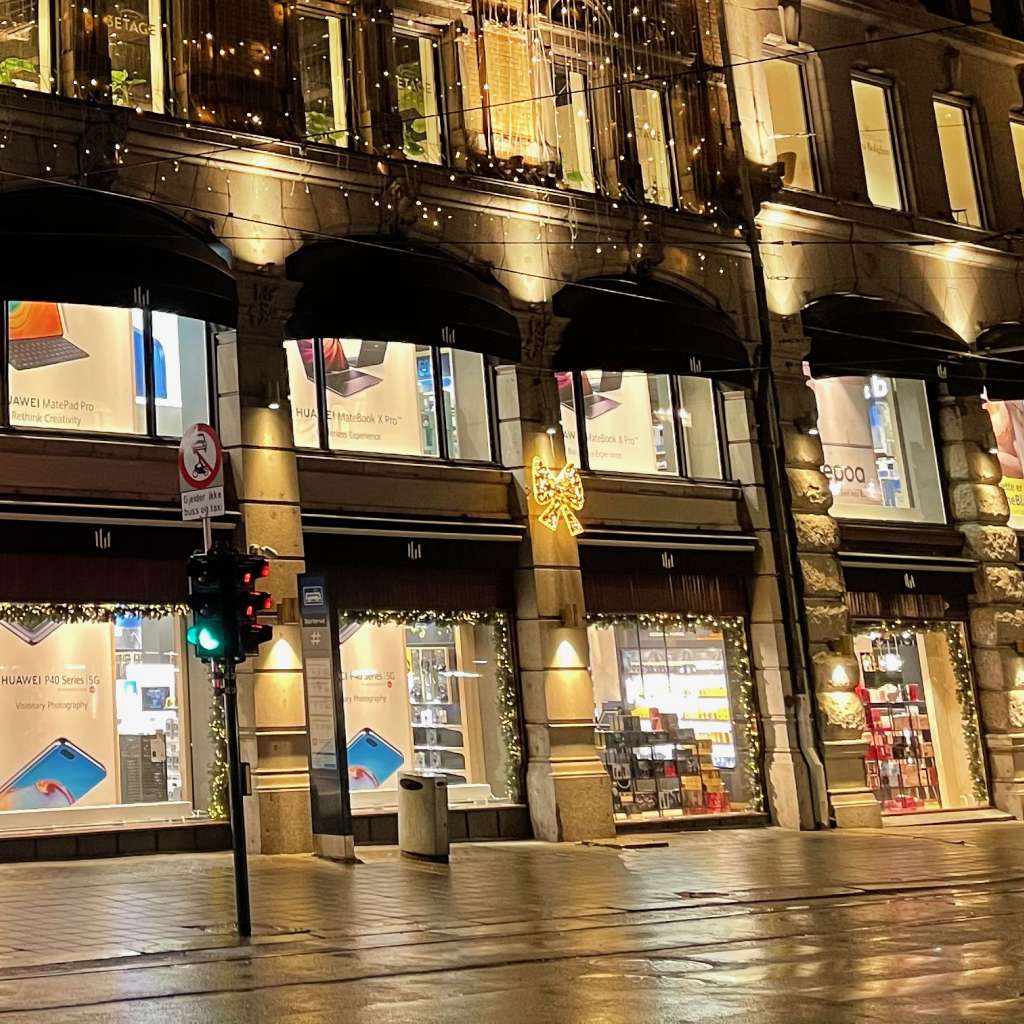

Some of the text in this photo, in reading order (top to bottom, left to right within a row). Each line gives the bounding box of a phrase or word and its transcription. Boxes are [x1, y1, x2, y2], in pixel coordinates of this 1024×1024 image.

[80, 401, 94, 412] Pro
[296, 408, 336, 420] HUAEI
[44, 414, 82, 426] Creativity
[208, 490, 222, 500] ikke
[184, 507, 199, 516] buss
[210, 504, 223, 513] taxi
[1, 675, 100, 685] HUAWEI P40 Series 5G
[16, 701, 88, 711] Visionary Photography
